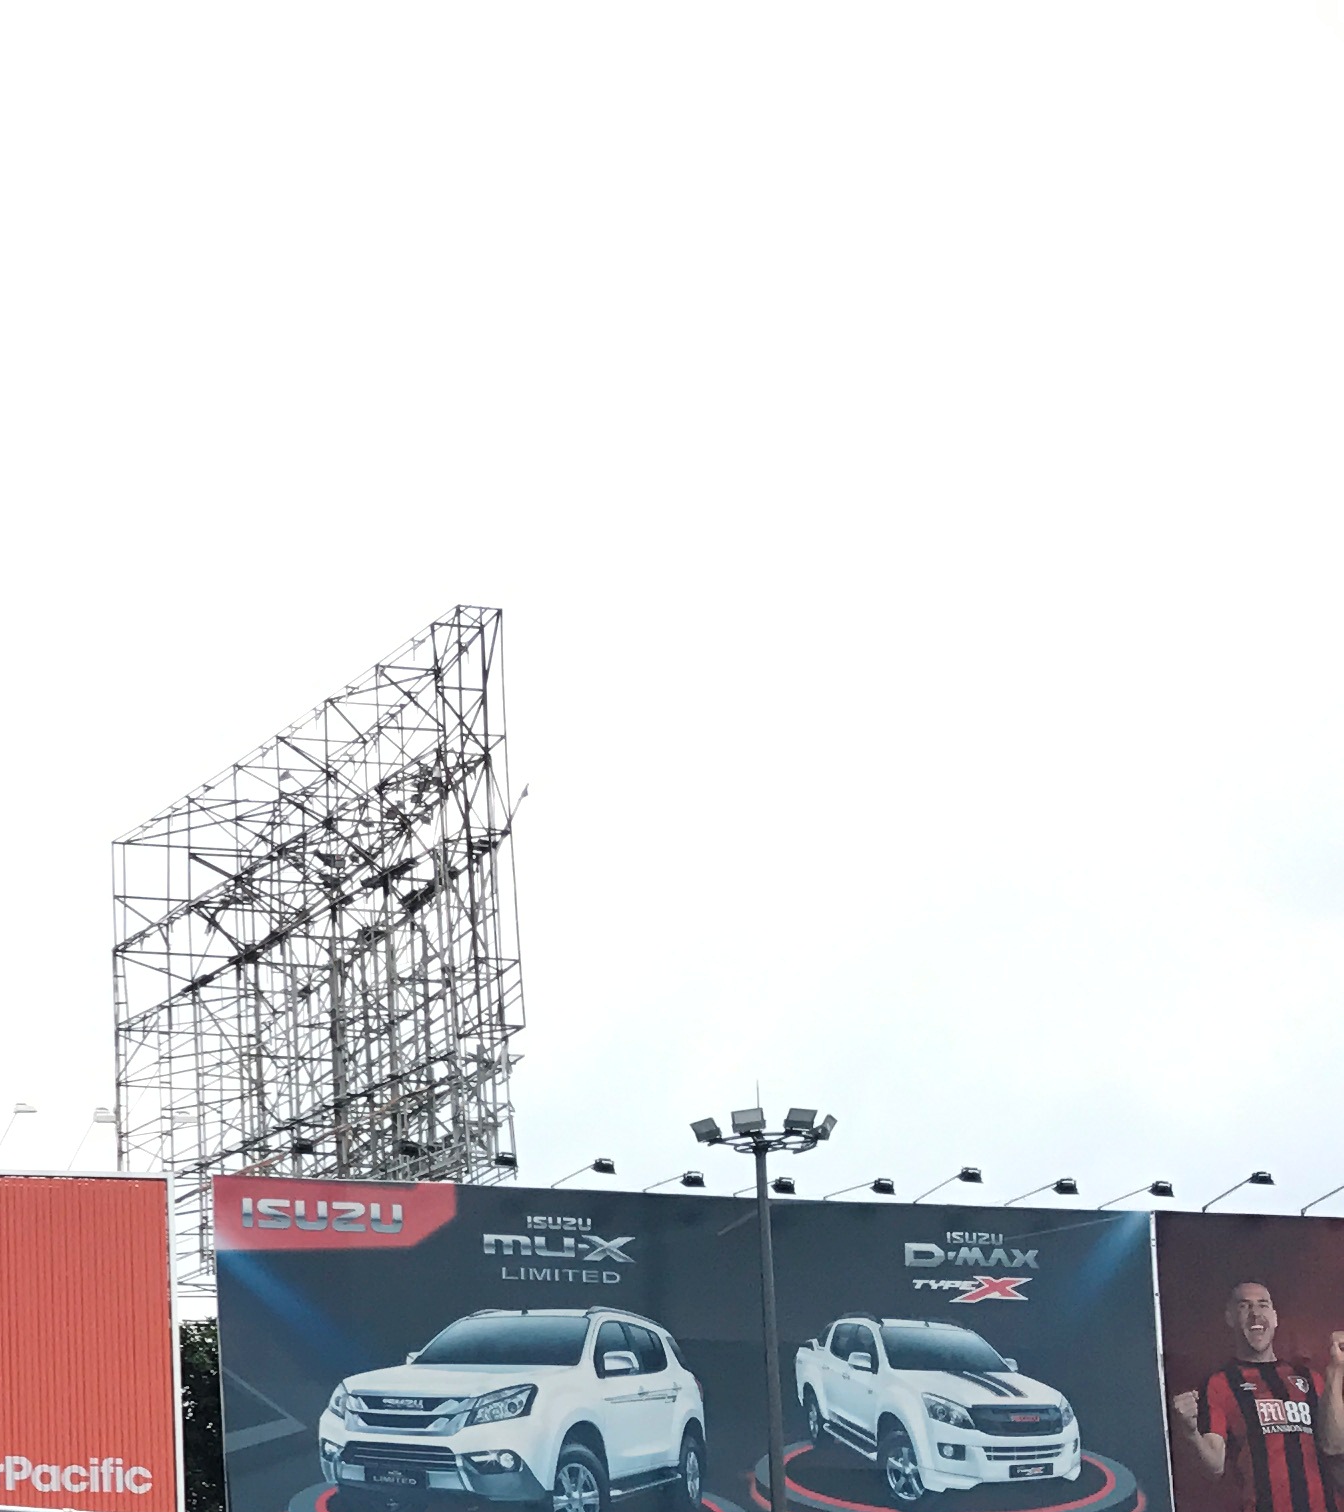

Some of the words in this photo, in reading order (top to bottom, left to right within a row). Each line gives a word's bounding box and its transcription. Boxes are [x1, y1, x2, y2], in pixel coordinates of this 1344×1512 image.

[242, 1197, 403, 1233] ISUZU
[526, 1215, 592, 1231] ISUZU
[946, 1231, 1003, 1245] ISUZU
[501, 1266, 621, 1285] LIMITED
